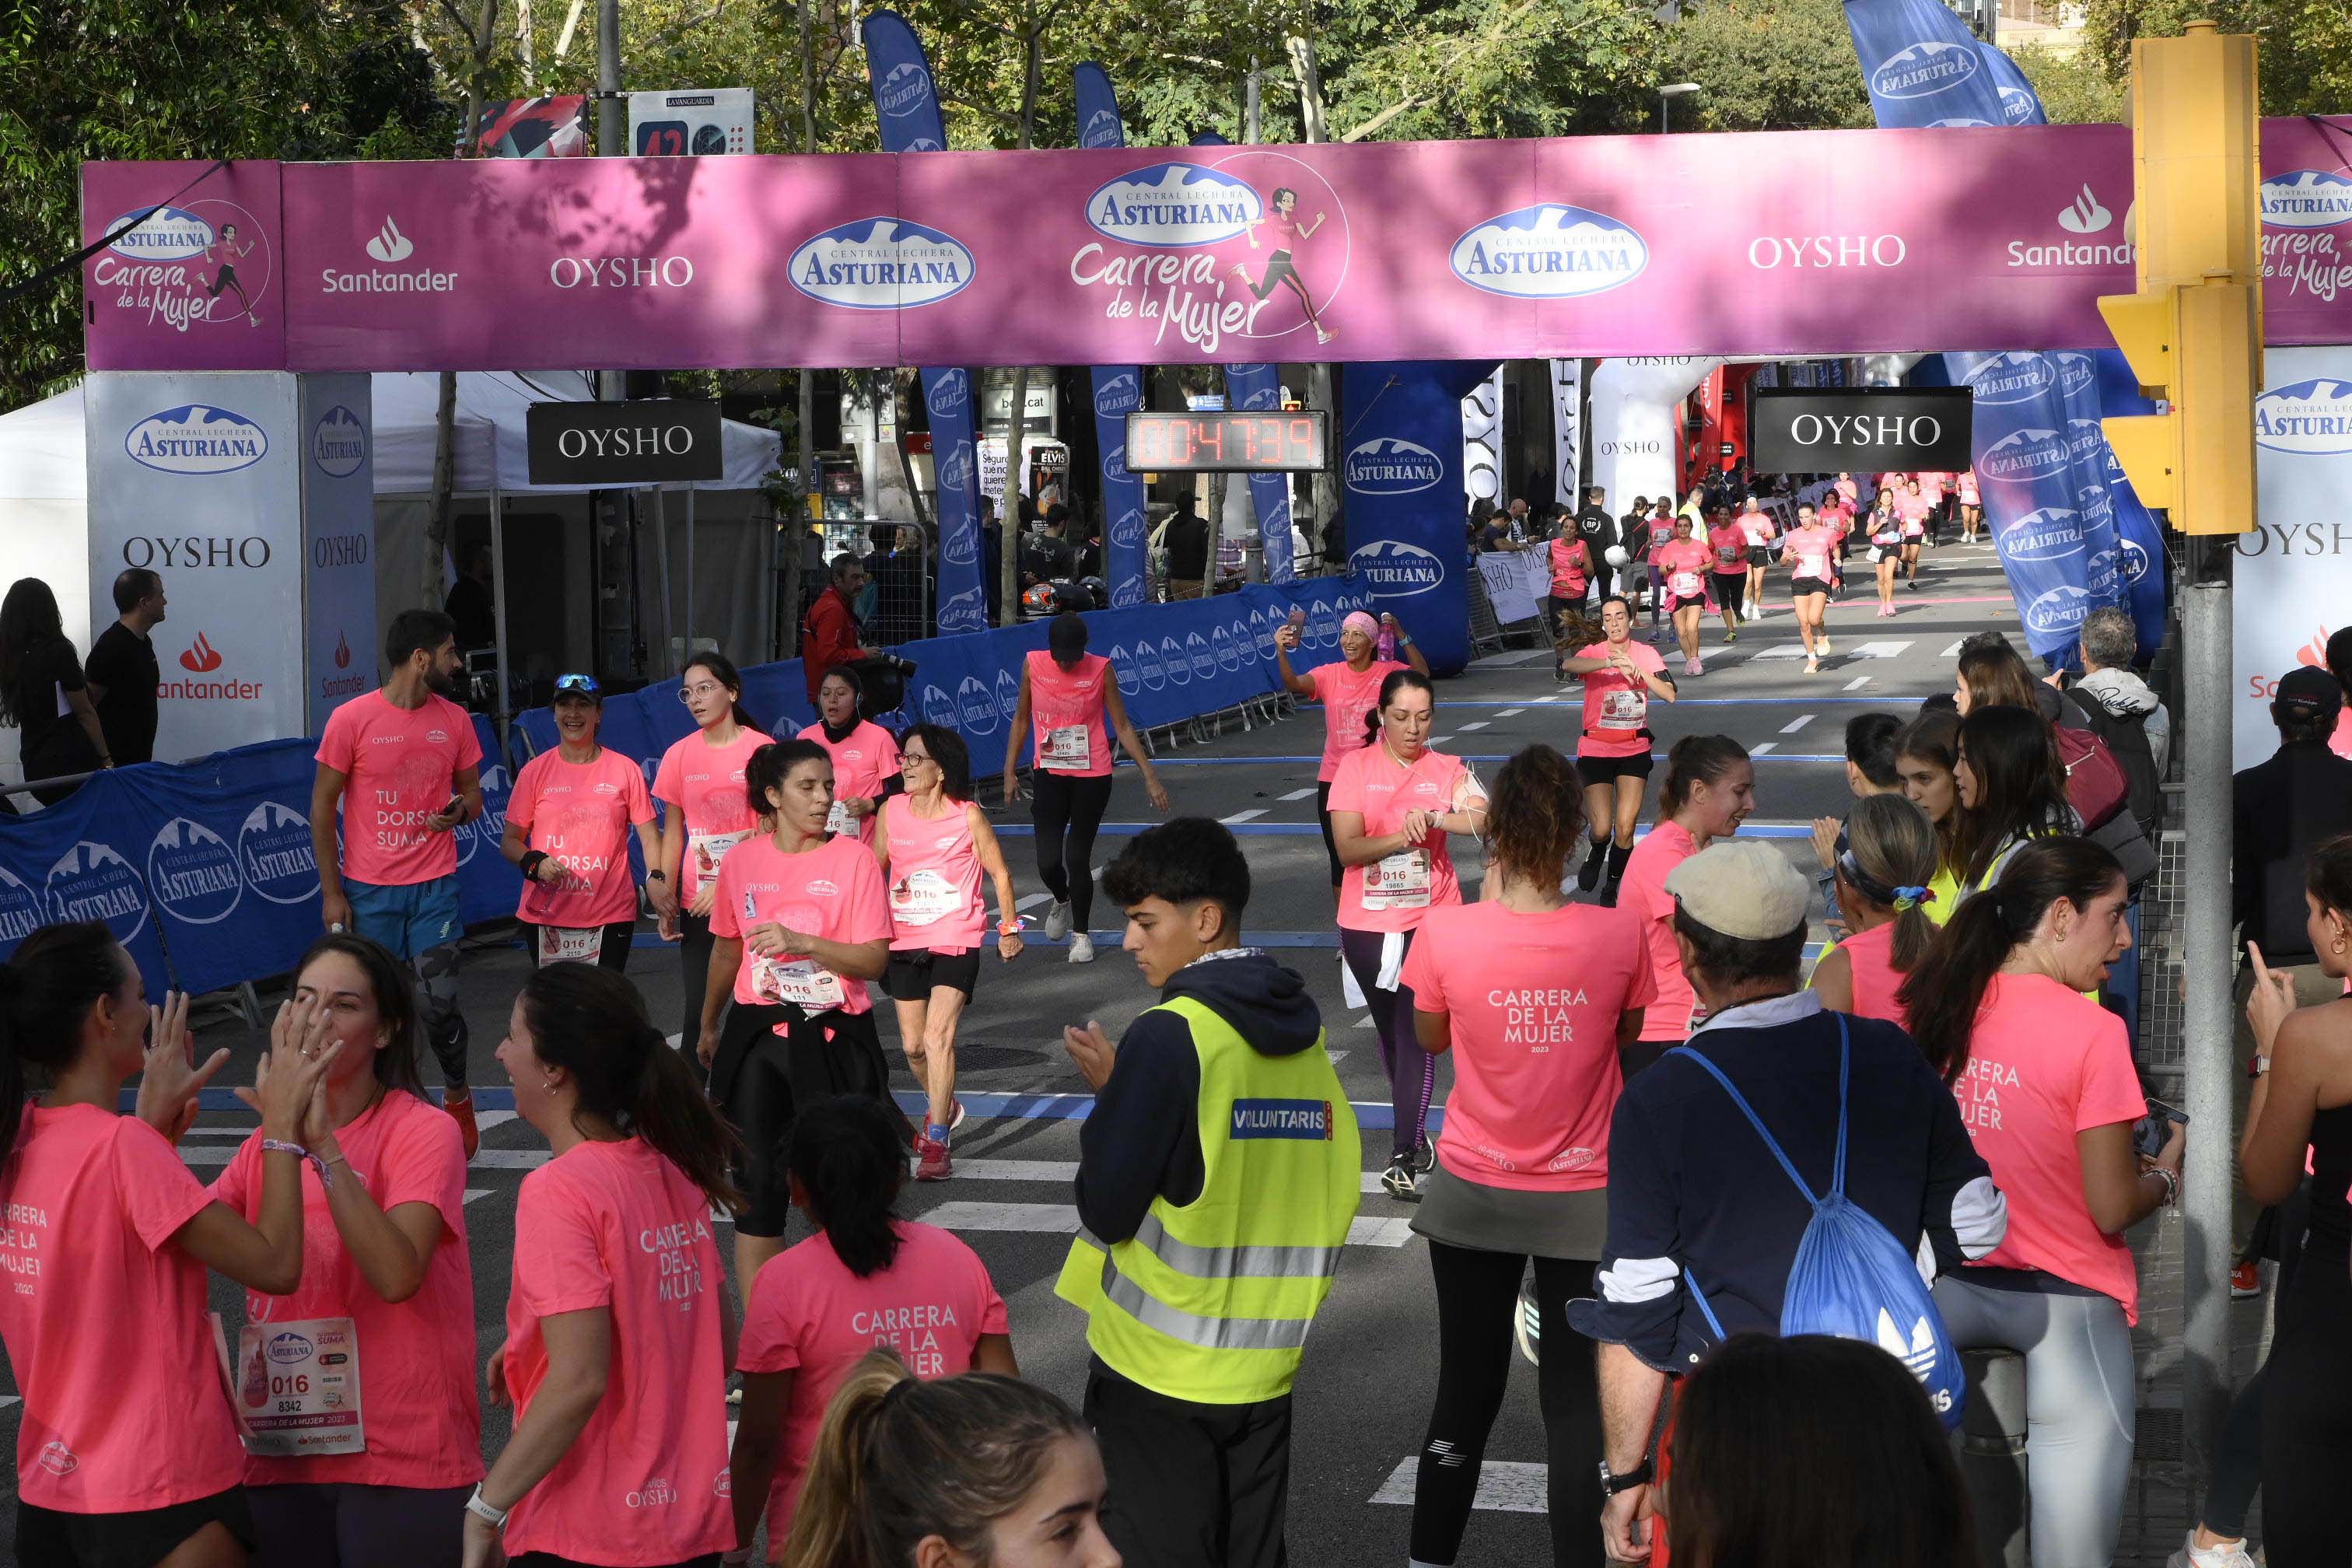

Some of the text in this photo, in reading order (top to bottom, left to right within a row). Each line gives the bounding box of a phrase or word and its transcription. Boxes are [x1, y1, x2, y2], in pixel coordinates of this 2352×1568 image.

[1126, 190, 1244, 201] CENTRAL LECHERA
[1100, 194, 1248, 227] ASTURIANA
[831, 248, 955, 259] CENTRAL LECHERA
[1748, 234, 1906, 269] OYSHO
[2260, 233, 2336, 256] arrera
[1070, 243, 1216, 287] Carrera
[1465, 240, 1633, 275] ASTURIANA
[94, 257, 186, 286] Carrera
[550, 257, 694, 289] OYSHO
[804, 252, 961, 286] ASTURIANA
[2279, 257, 2293, 278] la
[2289, 250, 2352, 302] Muje
[322, 268, 458, 293] Santander
[117, 284, 221, 332] de la Mujer
[1107, 281, 1272, 354] de la Mujer
[1002, 397, 1044, 409] b.cat
[2277, 405, 2329, 414] CENTRAL
[1790, 415, 1941, 446] OYSHO
[137, 431, 258, 457] ASTURIANA
[317, 432, 362, 461] ASTURIANA
[558, 425, 694, 458] OYSHO
[1139, 420, 1314, 464] 00:47:39
[1601, 440, 1660, 456] OYSHO
[1041, 453, 1065, 464] ELVIS
[1348, 461, 1436, 482] ASTURIANA
[1586, 520, 1597, 530] BP
[2233, 522, 2352, 557] OYSH
[123, 537, 271, 568] OYSHO
[315, 534, 367, 569] OYSHO
[1364, 567, 1437, 583] TURIANA
[156, 678, 263, 701] antander
[322, 675, 366, 699] Santander
[373, 735, 404, 744] OYSHO
[684, 773, 709, 782] OYSHO
[376, 790, 397, 805] TU
[544, 785, 572, 795] OYSHO
[377, 831, 427, 847] SUMA
[247, 844, 317, 884] ASTURIAN
[157, 861, 239, 904] ASTURIANA
[1383, 871, 1406, 880] 016
[744, 883, 779, 893] OYSHO
[563, 940, 585, 949] 016
[782, 983, 812, 995] 016
[1487, 988, 1589, 1008] CARRERA
[1507, 1006, 1570, 1025] DE LA
[1504, 1024, 1574, 1044] MUJER
[1973, 1080, 1999, 1108] LA
[1234, 1110, 1325, 1129] VOLUNTARIS
[1552, 1155, 1593, 1171] ASTURIANA
[20, 1231, 38, 1251] LA
[852, 1304, 957, 1335] CARRERA
[317, 1336, 345, 1345] SUMA
[910, 1328, 939, 1352] LA
[271, 1346, 309, 1357] ASTURIANA
[271, 1374, 310, 1395] 016
[278, 1400, 302, 1413] 8342
[298, 1417, 325, 1426] MUJER
[307, 1434, 351, 1445] Santander
